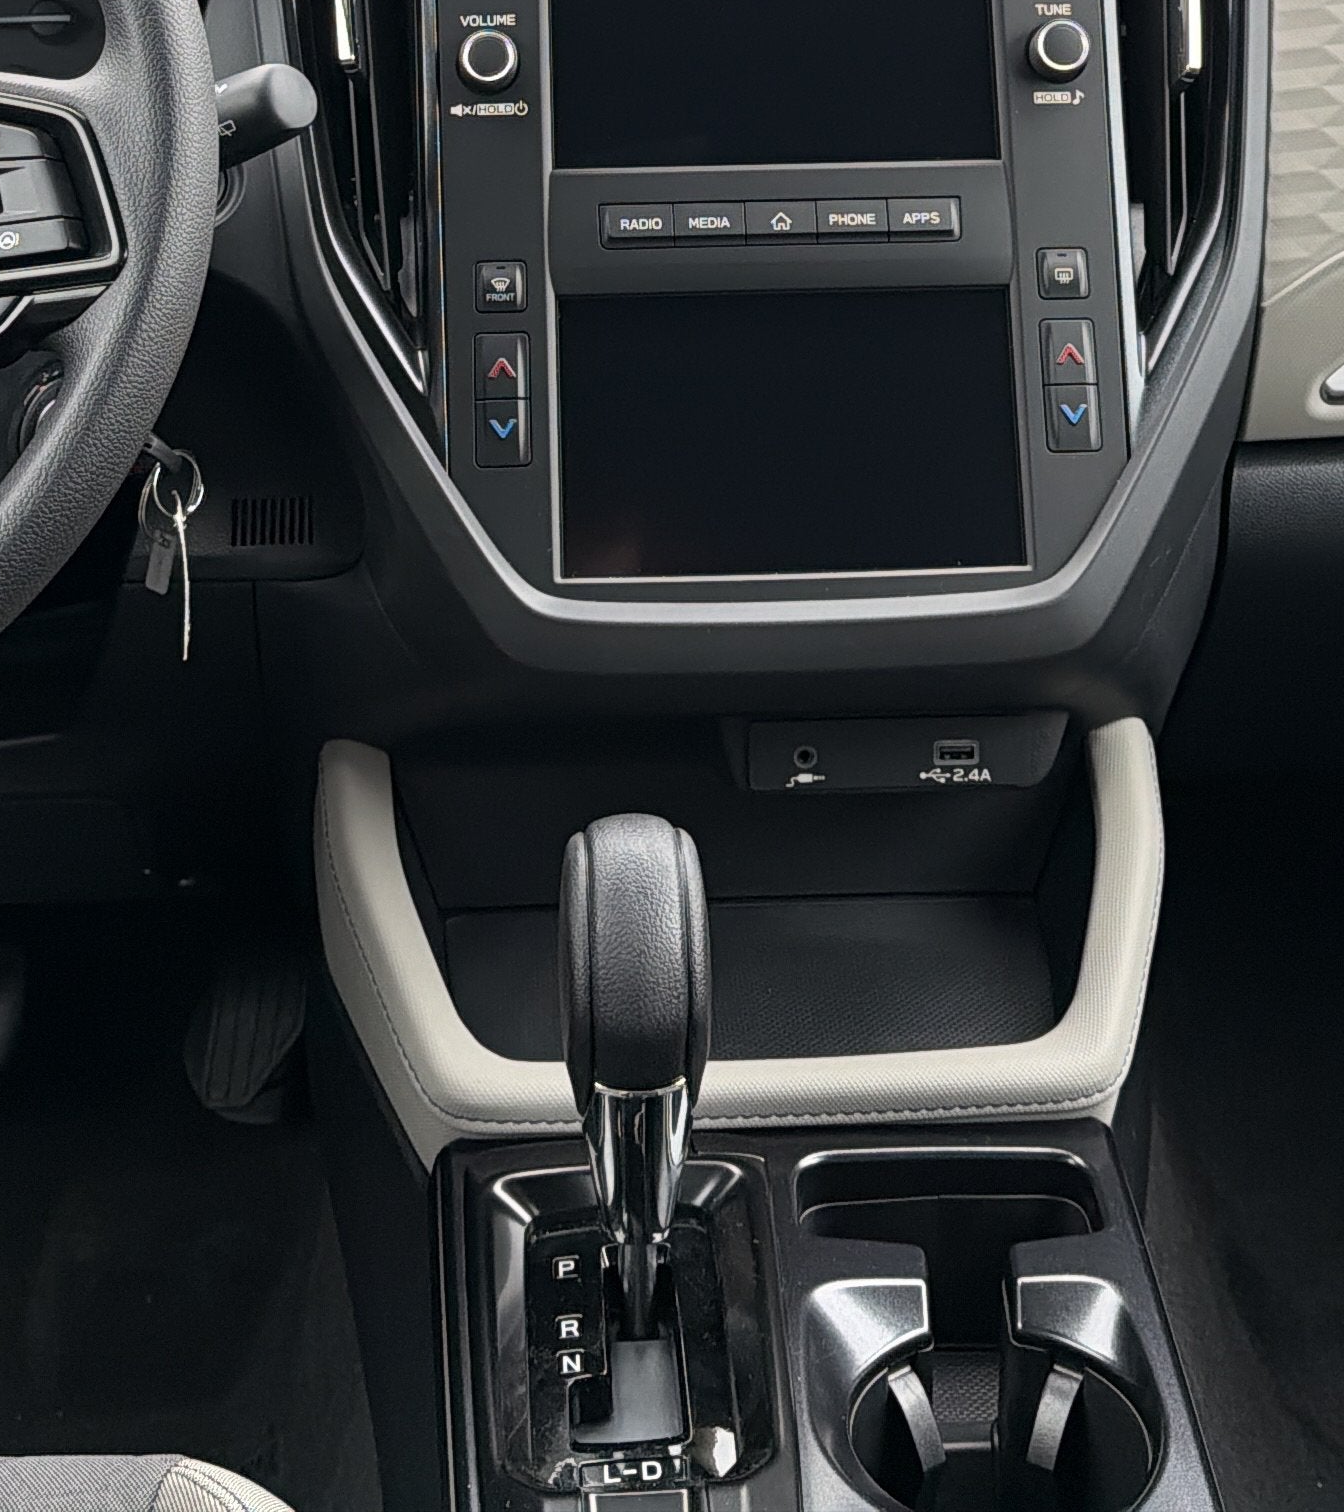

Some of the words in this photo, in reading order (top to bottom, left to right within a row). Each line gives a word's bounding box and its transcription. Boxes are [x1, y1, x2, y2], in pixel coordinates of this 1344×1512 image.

[1035, 3, 1072, 16] TUNE
[459, 14, 516, 27] VOLUME
[1034, 92, 1070, 103] HOLD
[477, 104, 513, 115] HOLD
[620, 218, 662, 230] RADIO
[688, 216, 731, 229] MEDIA
[828, 214, 876, 226] PHONE
[903, 212, 940, 224] APPS
[486, 293, 515, 302] FRONT
[953, 768, 992, 782] 2.4A
[557, 1261, 575, 1279] P
[560, 1319, 579, 1338] R
[562, 1354, 581, 1373] N
